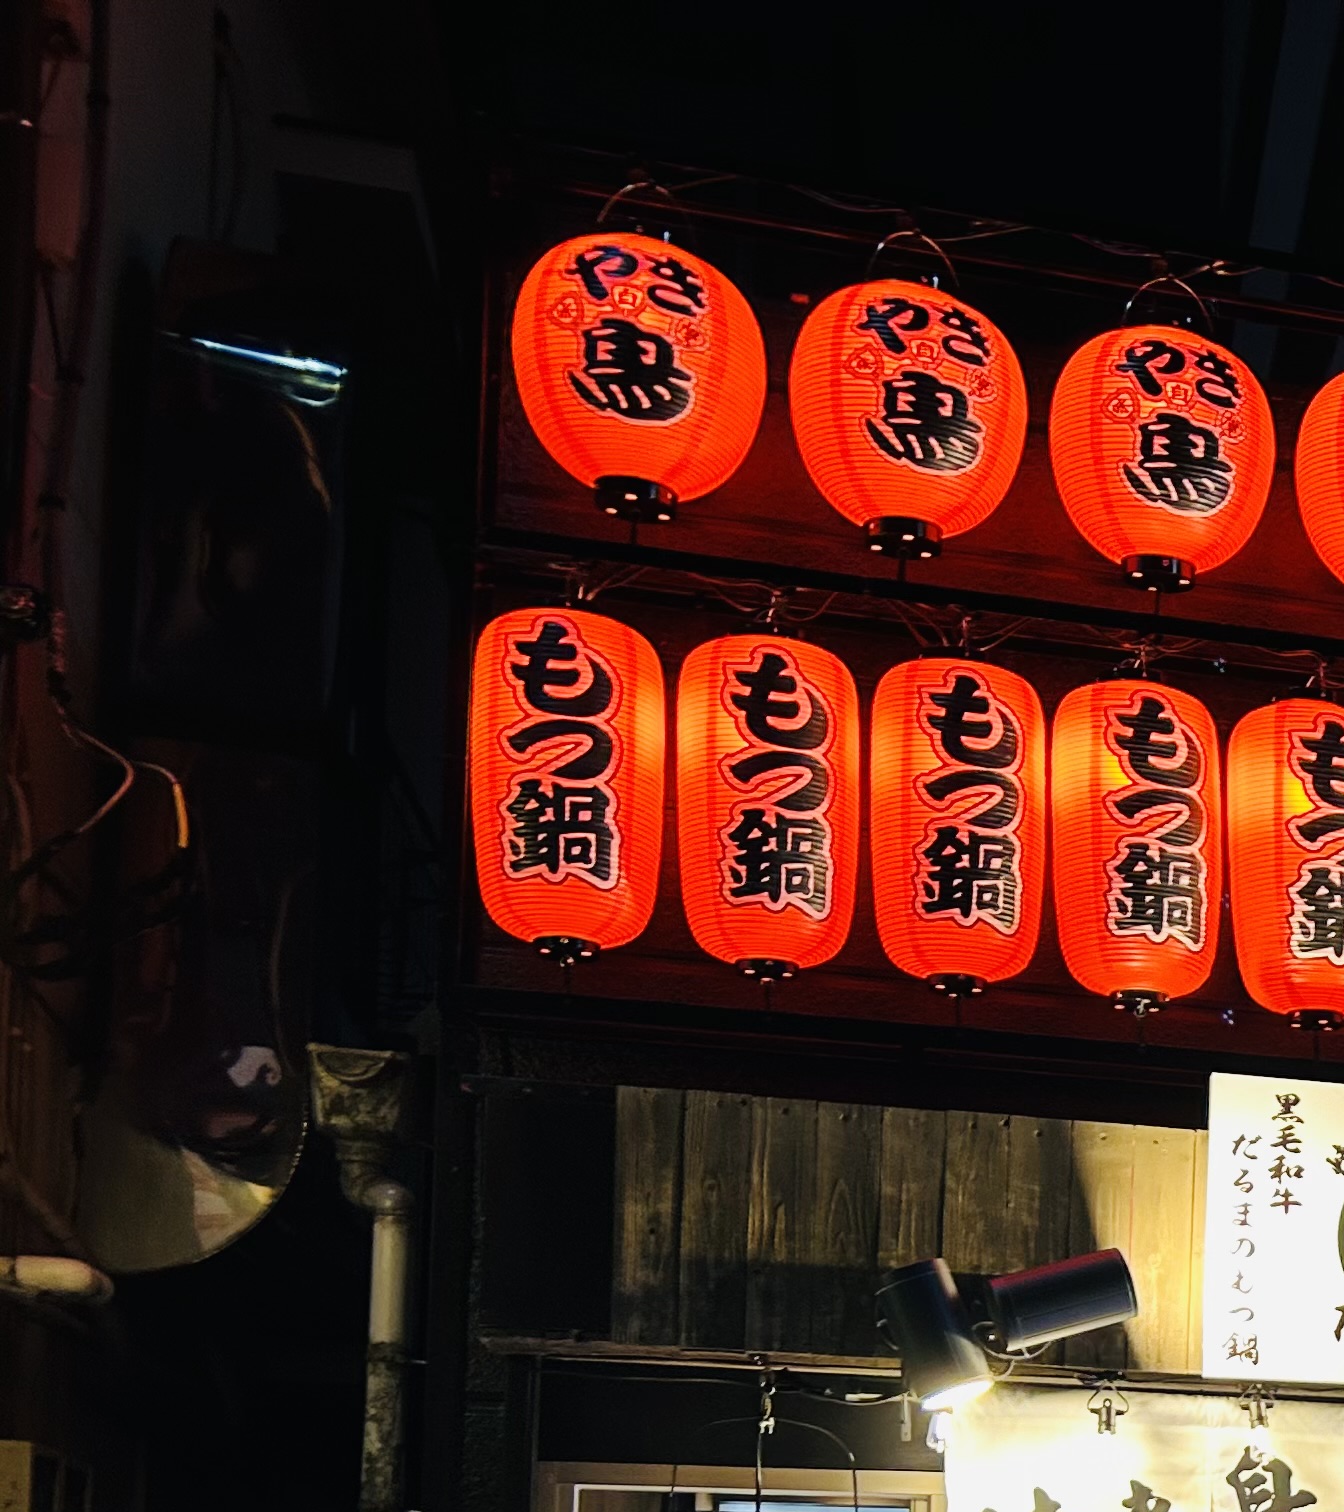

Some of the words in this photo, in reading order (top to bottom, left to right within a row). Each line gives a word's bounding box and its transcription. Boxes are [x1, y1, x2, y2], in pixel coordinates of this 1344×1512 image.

[507, 620, 613, 883] もつ鍋
[727, 655, 831, 914] もつ鍋
[921, 674, 1020, 930] もつ鍋
[1109, 697, 1203, 948] もつ鍋
[1221, 1132, 1263, 1366] だるまのもつ鍋
[1267, 1093, 1305, 1215] 黒毛和牛
